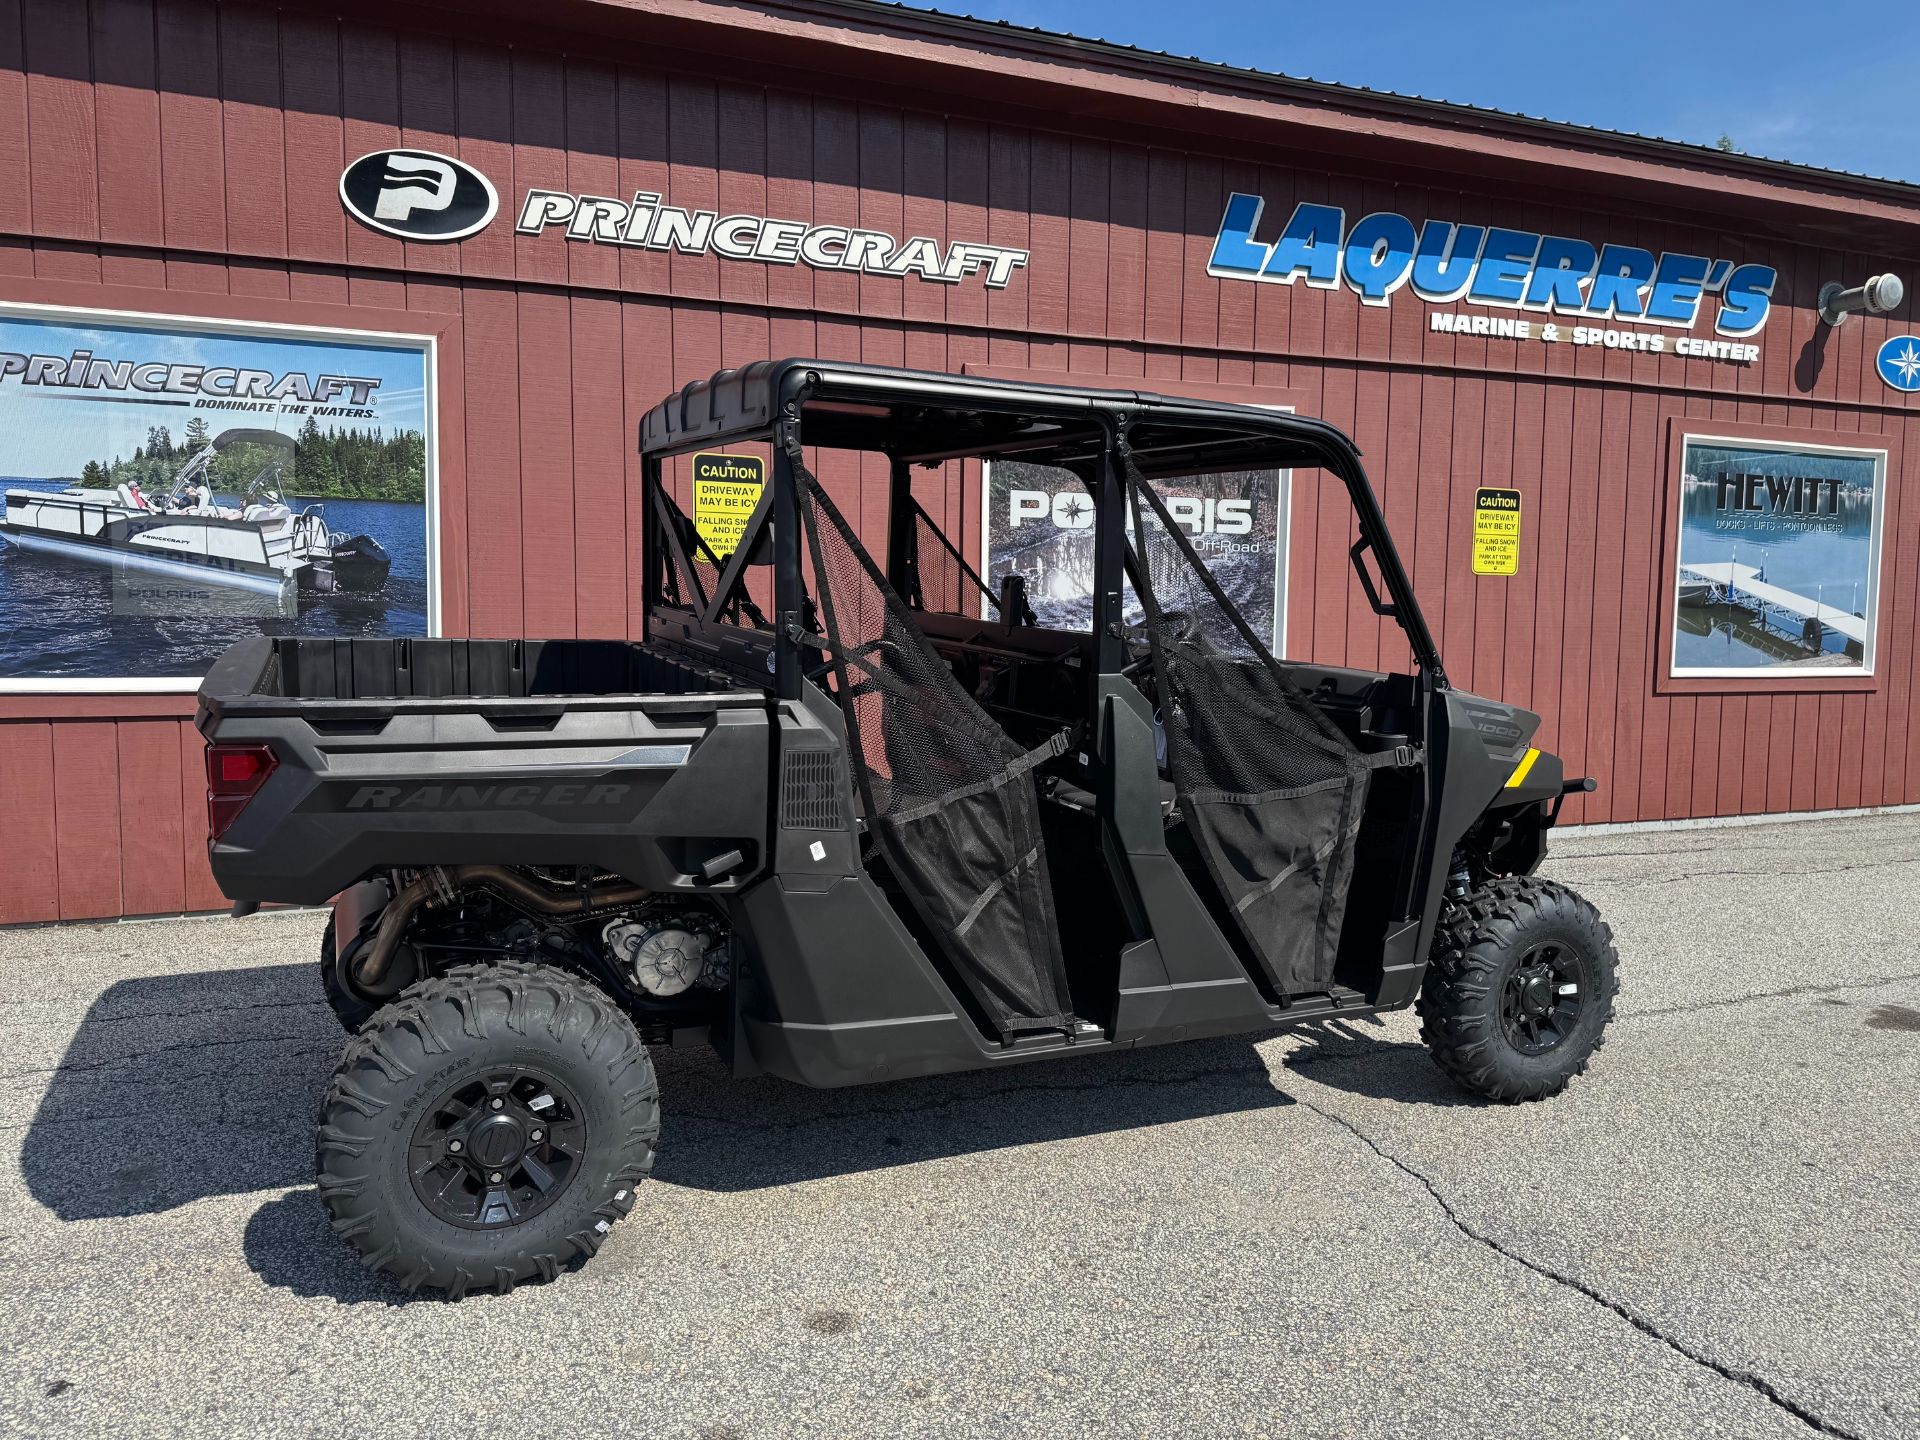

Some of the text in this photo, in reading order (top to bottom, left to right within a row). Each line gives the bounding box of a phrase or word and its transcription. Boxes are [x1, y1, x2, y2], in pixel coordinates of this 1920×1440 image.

[1206, 192, 1776, 338] LAQUERRE'S
[1430, 312, 1759, 362] MARINE & SPORTS CENTER
[194, 399, 276, 413] DOMINATE
[280, 404, 308, 415] THE
[700, 465, 757, 479] CAUTION
[702, 485, 755, 496] DRIVEWAY
[1717, 472, 1844, 515] HEWITT
[699, 497, 758, 508] MAY BE ICY
[1480, 497, 1517, 508] CAUTION
[697, 517, 749, 526] FALLING SN
[1480, 513, 1515, 521] DRIVEWAY
[712, 526, 746, 535] AND ICE
[1716, 520, 1746, 530] DOCKS
[1754, 521, 1776, 531] LIFTS
[1783, 522, 1821, 532] PONTOON
[1823, 523, 1843, 533] LEGS
[1193, 539, 1260, 553] Off-Road
[1478, 722, 1521, 738] 1000
[346, 784, 631, 808] RANGER
